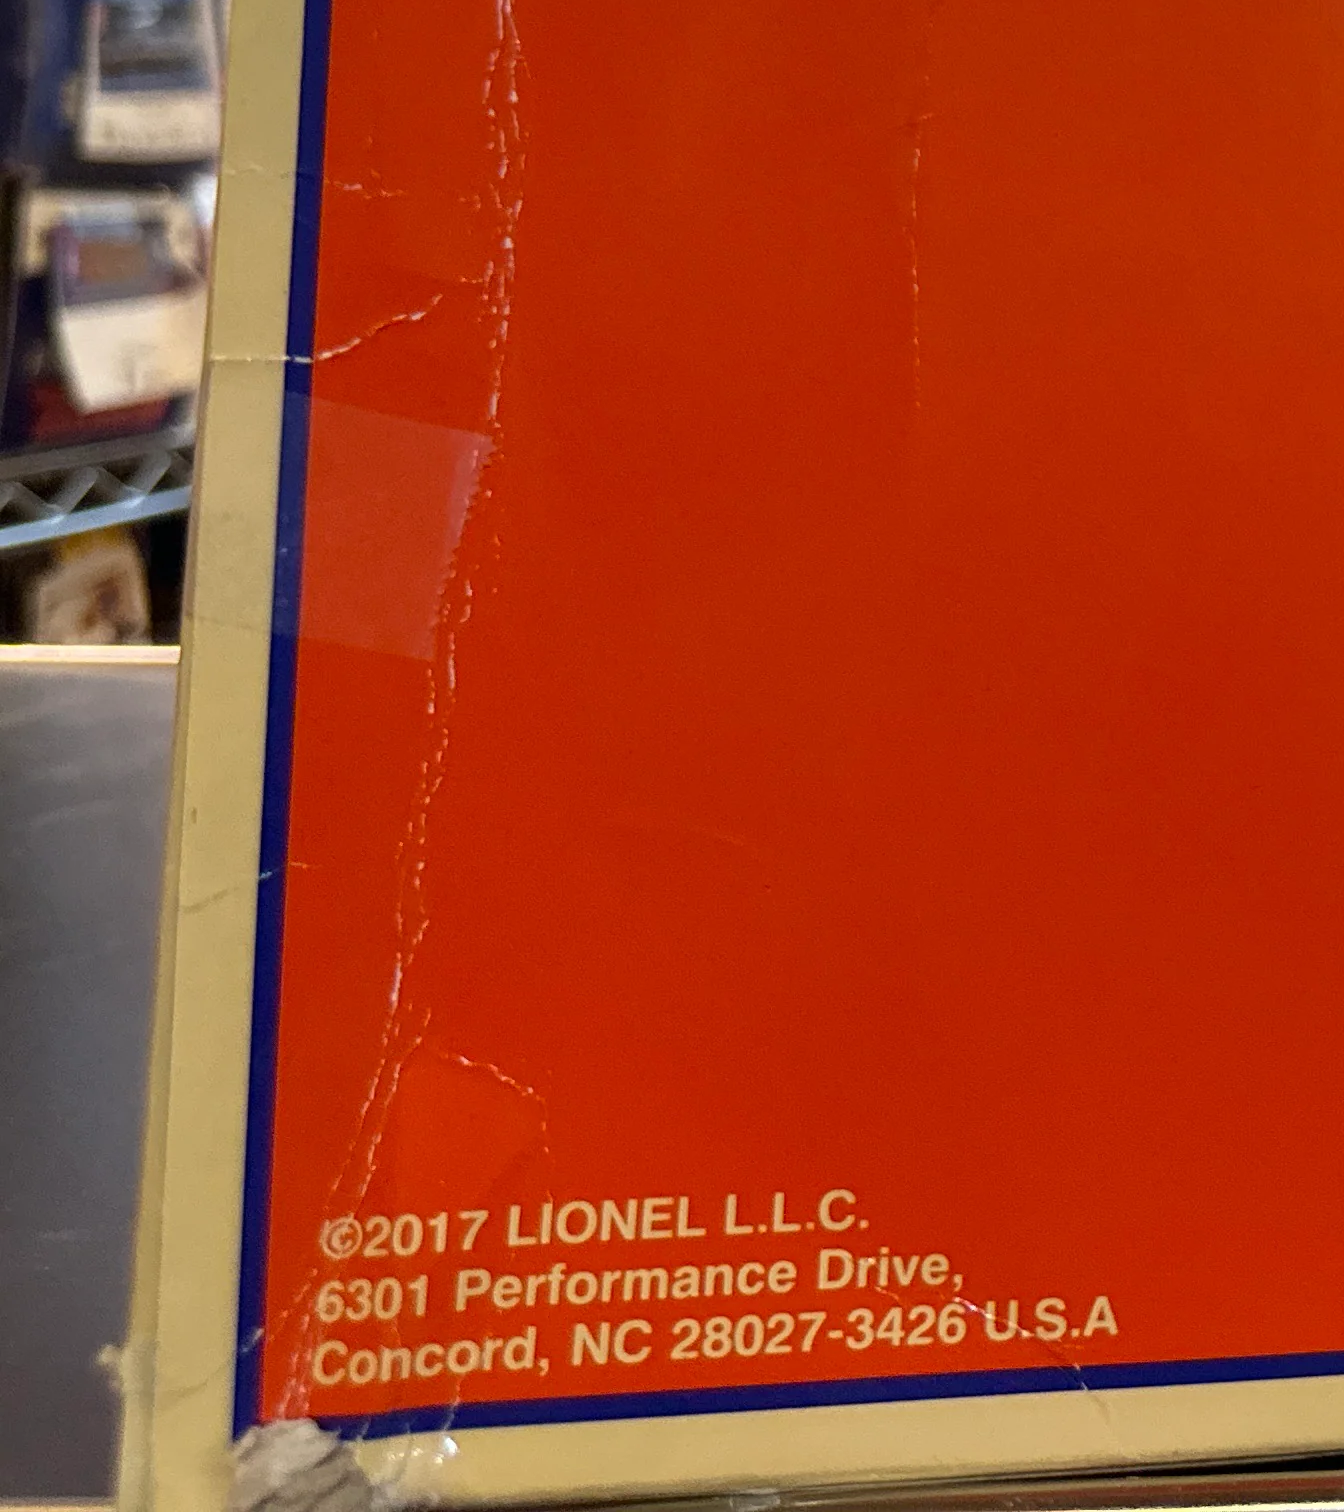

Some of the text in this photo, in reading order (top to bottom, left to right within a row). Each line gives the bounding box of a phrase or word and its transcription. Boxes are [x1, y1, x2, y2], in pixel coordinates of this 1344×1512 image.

[508, 1196, 706, 1246] LIONEL
[723, 1188, 870, 1236] L.L.C.
[315, 1246, 964, 1324] 6301 Performance Drive,
[312, 1295, 1120, 1387] Concord, NC 28027-3426 U.S.A
